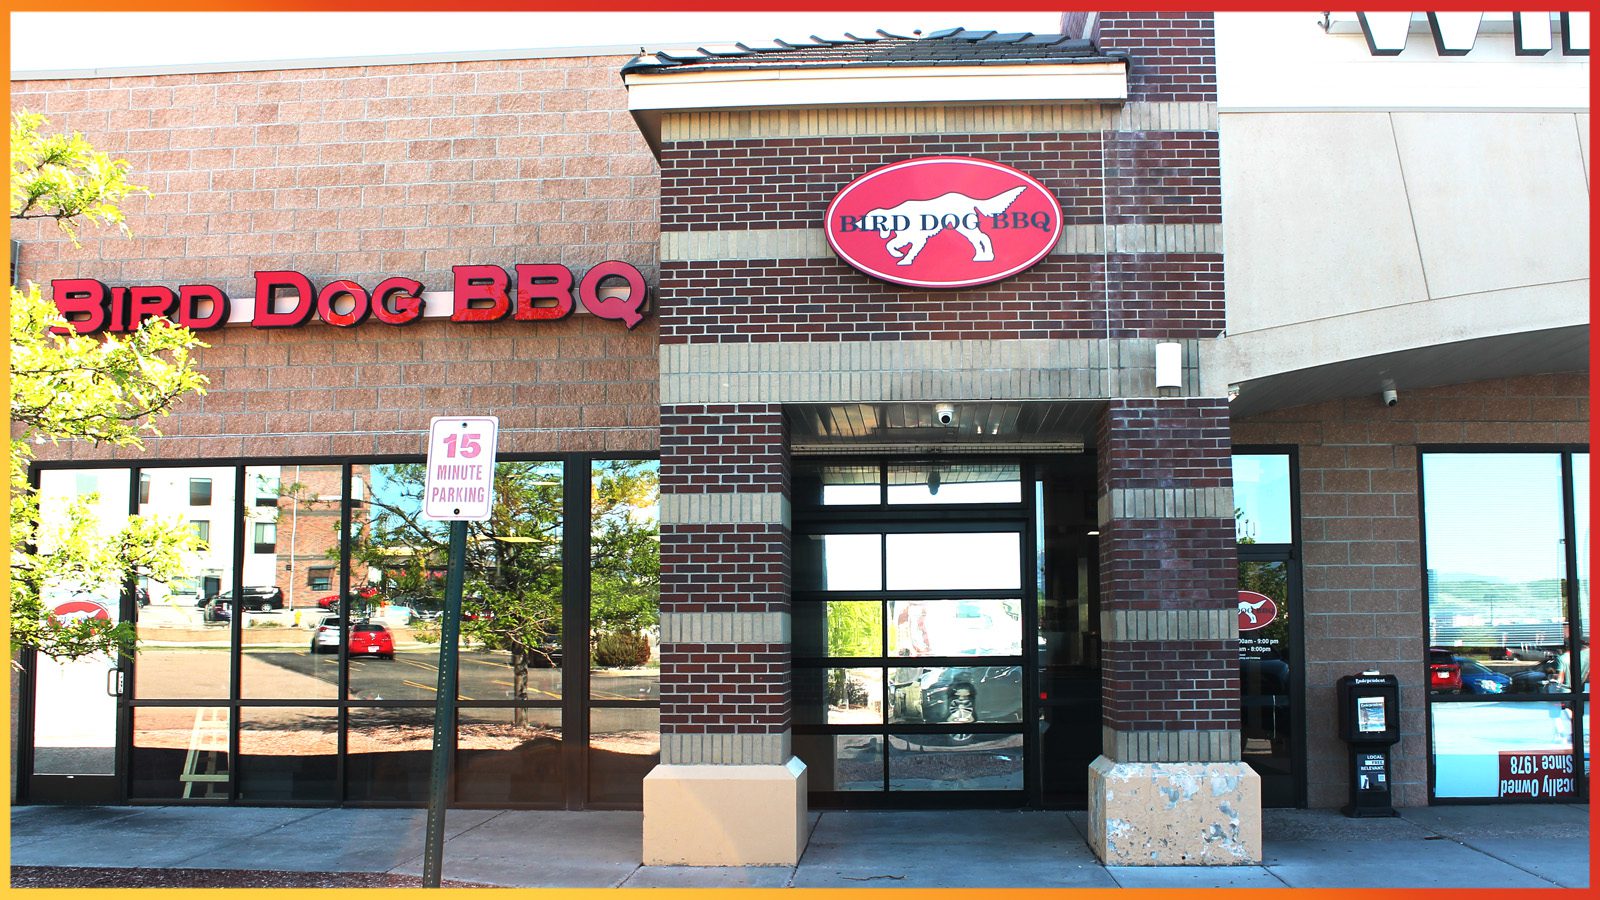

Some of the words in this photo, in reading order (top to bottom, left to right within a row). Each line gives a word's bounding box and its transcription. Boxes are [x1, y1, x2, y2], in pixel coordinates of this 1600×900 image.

[839, 214, 911, 233] BIRD
[920, 213, 981, 231] DOG
[991, 211, 1051, 233] BBQ
[49, 278, 230, 335] BIRD
[252, 270, 426, 329] DOG
[450, 259, 648, 331] BBQ
[443, 433, 482, 459] 15
[437, 465, 483, 481] MINUTE
[431, 487, 485, 503] PARKING
[1510, 755, 1538, 775] 1978
[1541, 754, 1573, 774] Since
[1500, 778, 1538, 797] Owned
